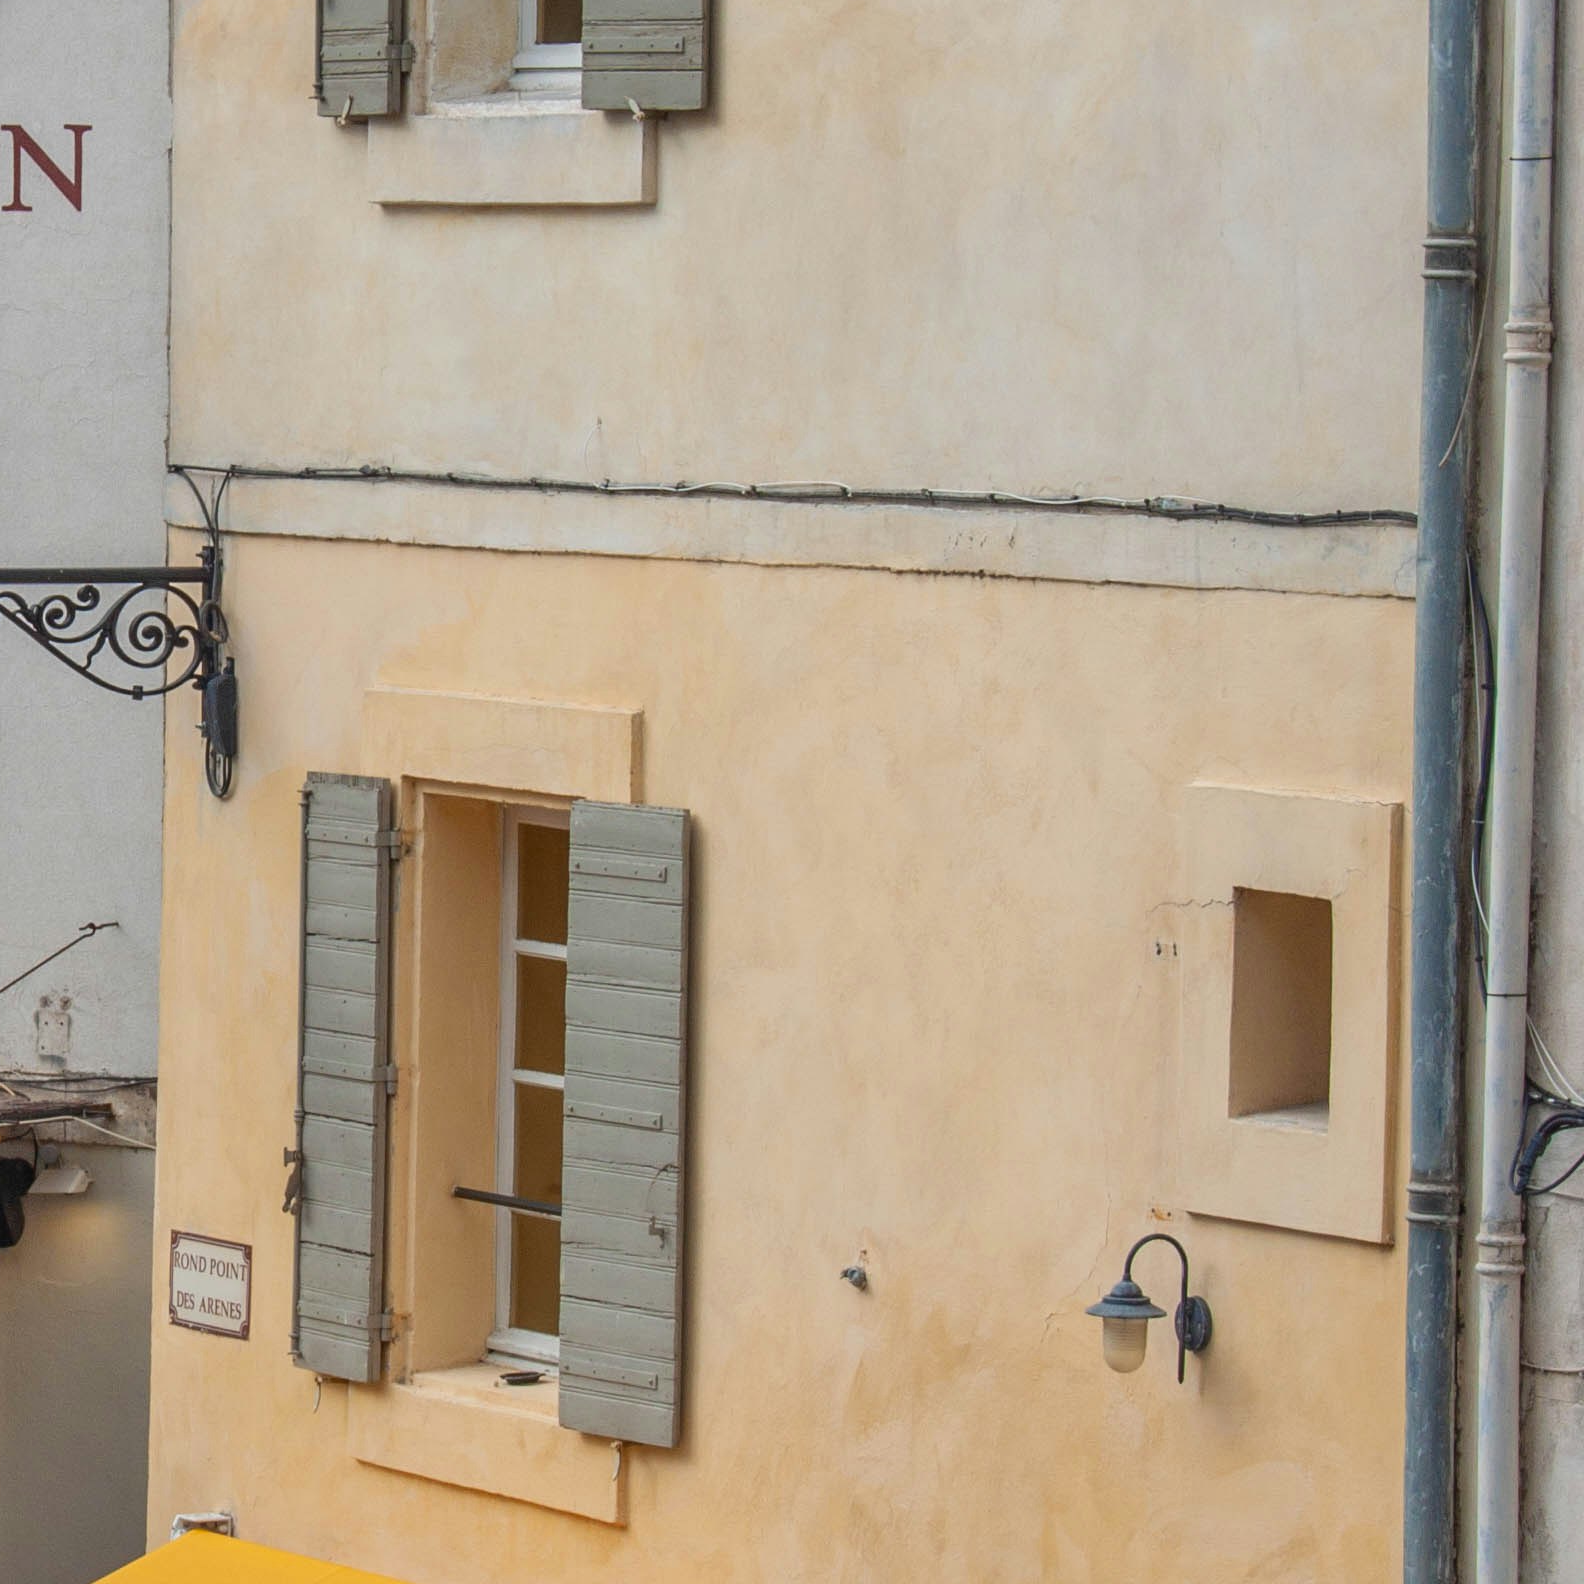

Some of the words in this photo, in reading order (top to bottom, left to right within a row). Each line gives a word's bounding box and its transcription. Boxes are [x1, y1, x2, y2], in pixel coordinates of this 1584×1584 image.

[173, 1250, 207, 1273] ROND
[209, 1257, 248, 1282] POINT
[176, 1289, 195, 1310] DES
[199, 1296, 242, 1320] ARENES
